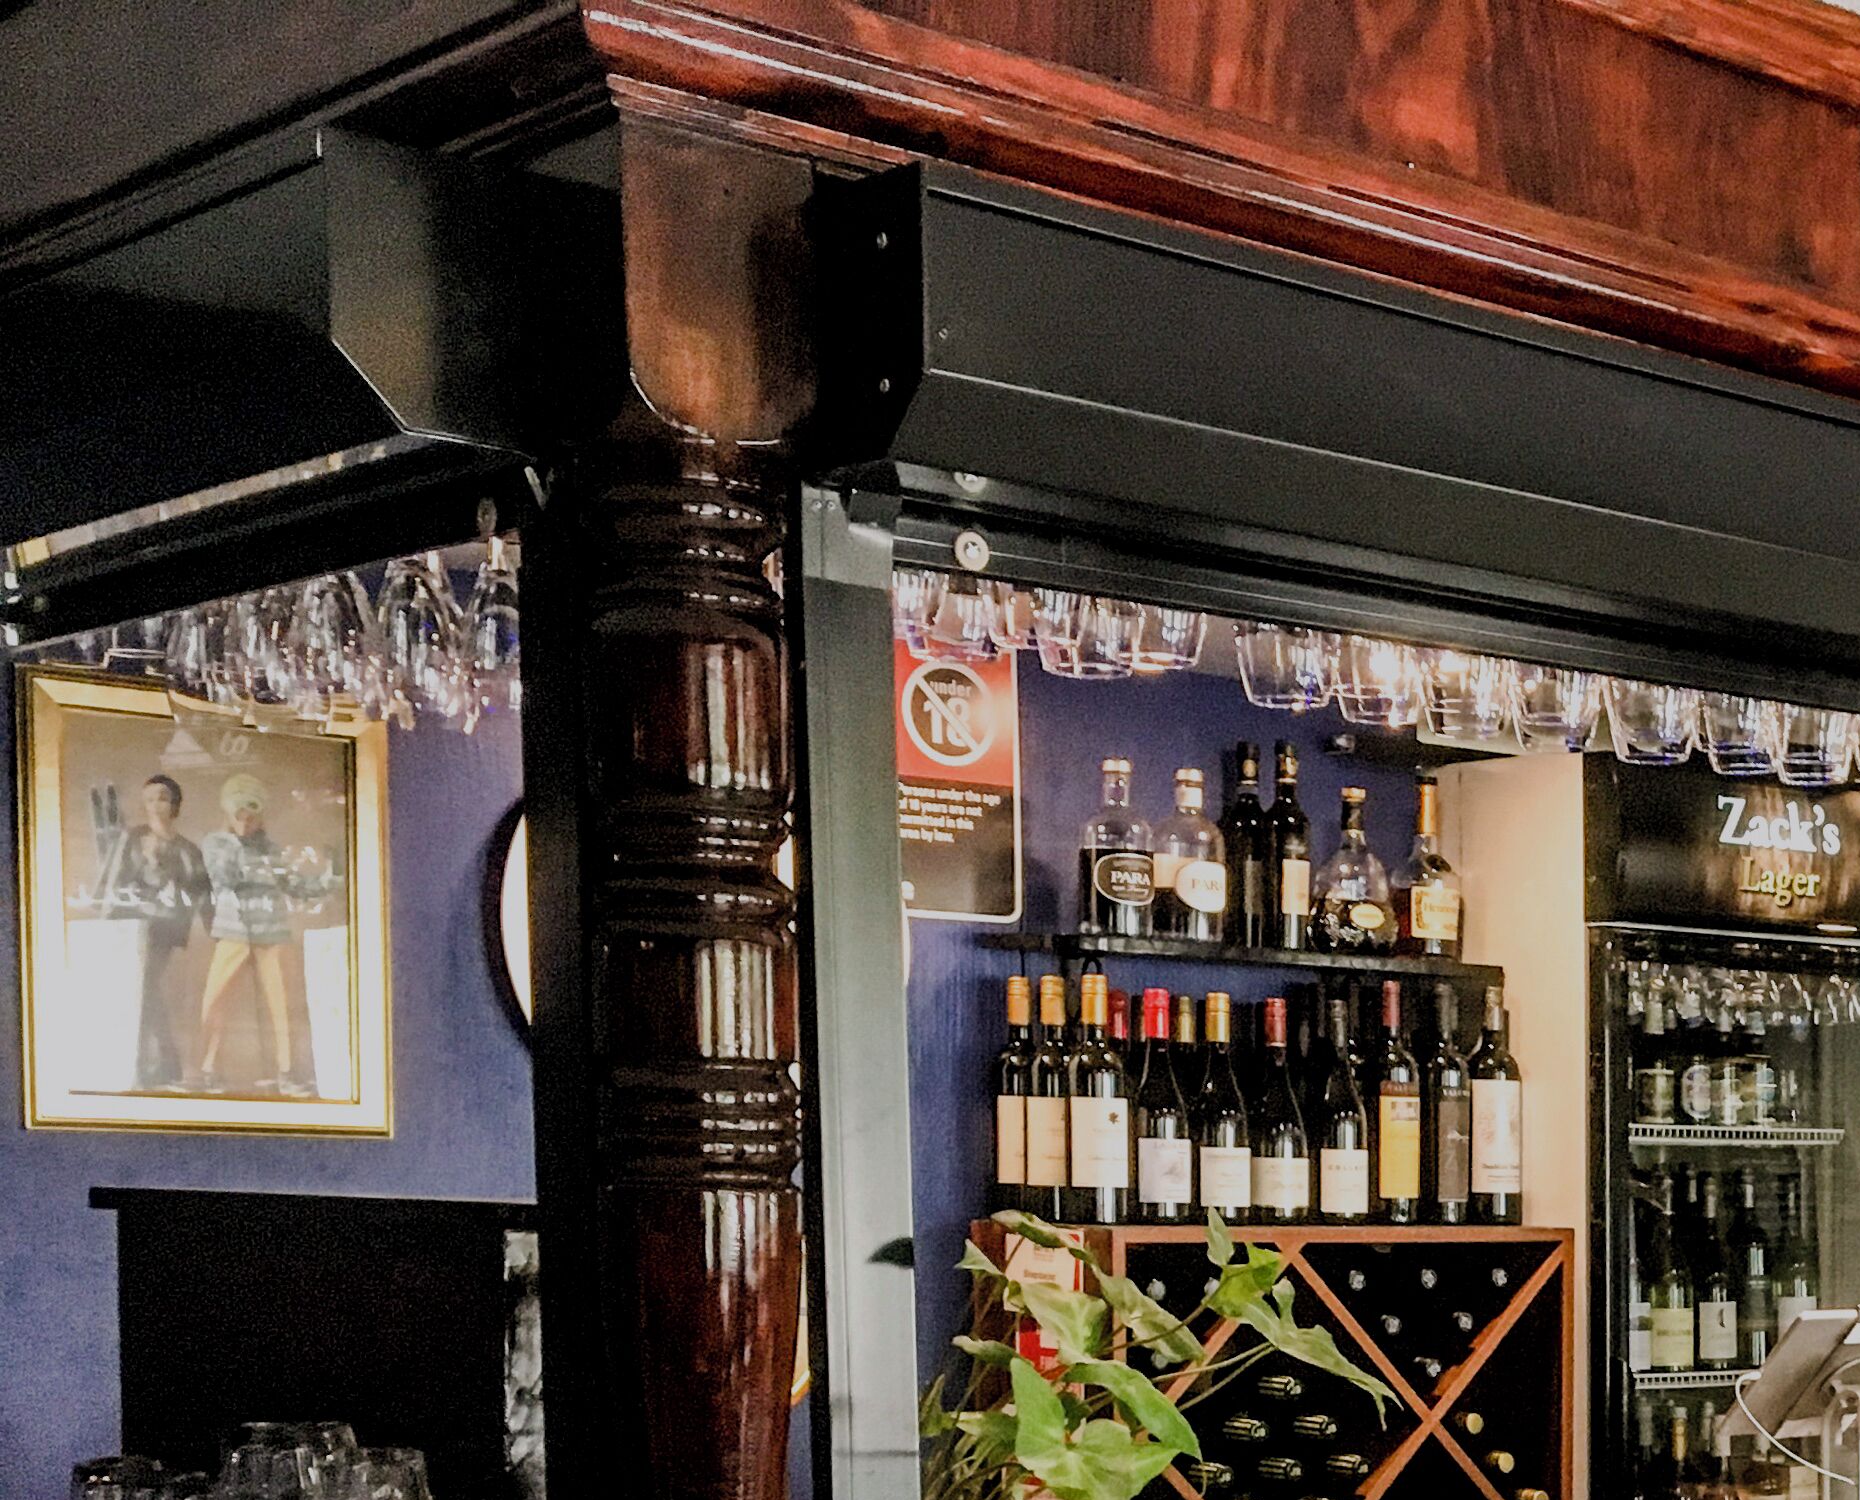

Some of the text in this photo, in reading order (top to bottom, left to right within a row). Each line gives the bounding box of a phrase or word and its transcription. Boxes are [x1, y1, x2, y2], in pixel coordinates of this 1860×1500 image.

[923, 698, 970, 748] 18
[1717, 794, 1841, 855] Zack's
[1110, 870, 1152, 887] PARA
[1739, 854, 1821, 907] Lager
